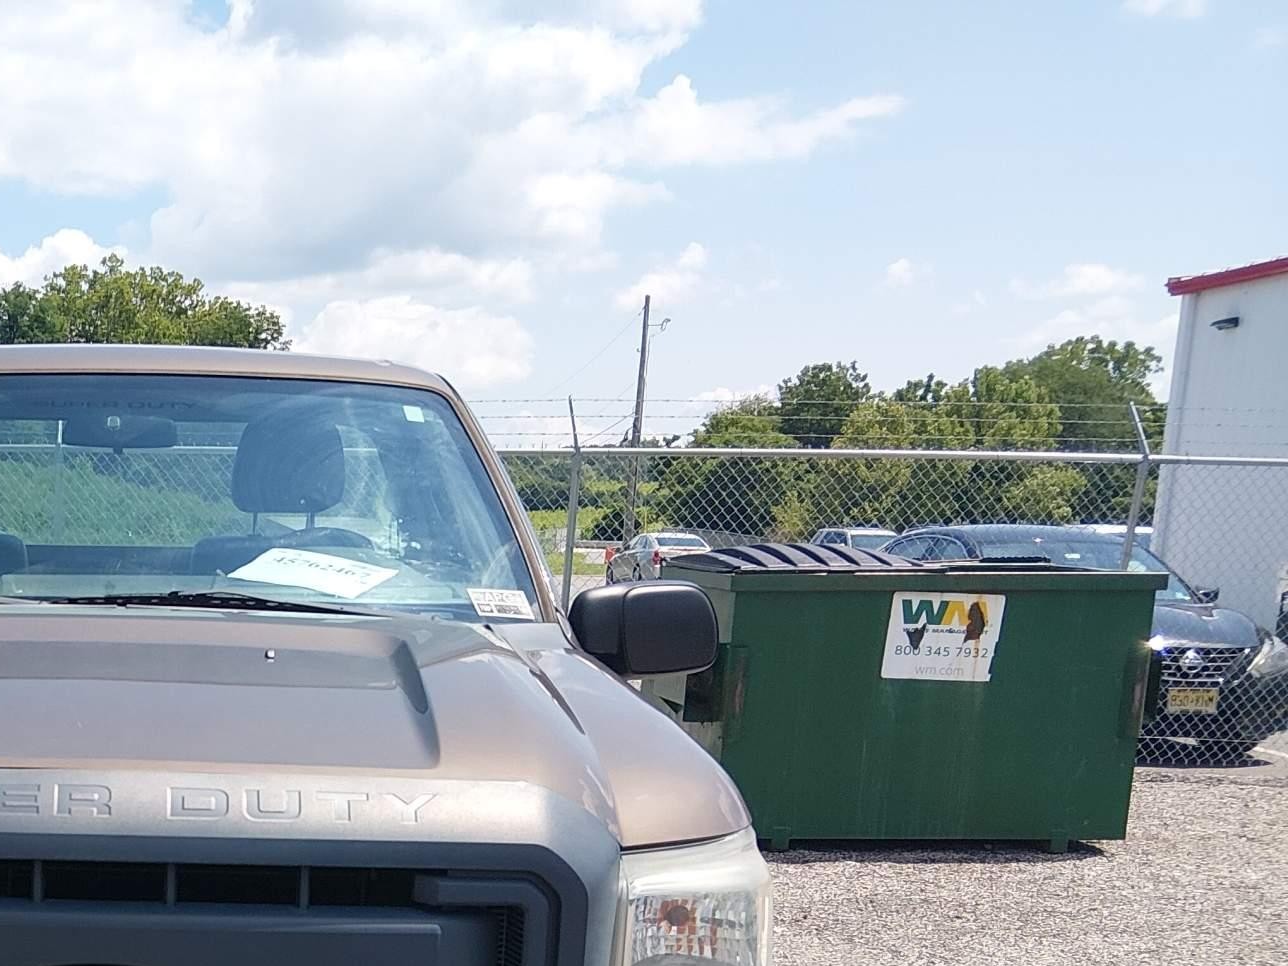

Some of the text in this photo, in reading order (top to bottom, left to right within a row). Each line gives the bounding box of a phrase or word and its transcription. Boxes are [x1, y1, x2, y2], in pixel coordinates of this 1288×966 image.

[901, 599, 989, 626] WM
[894, 645, 989, 658] 800 345 7932
[914, 665, 964, 677] wm.com
[165, 786, 440, 825] DUTY
